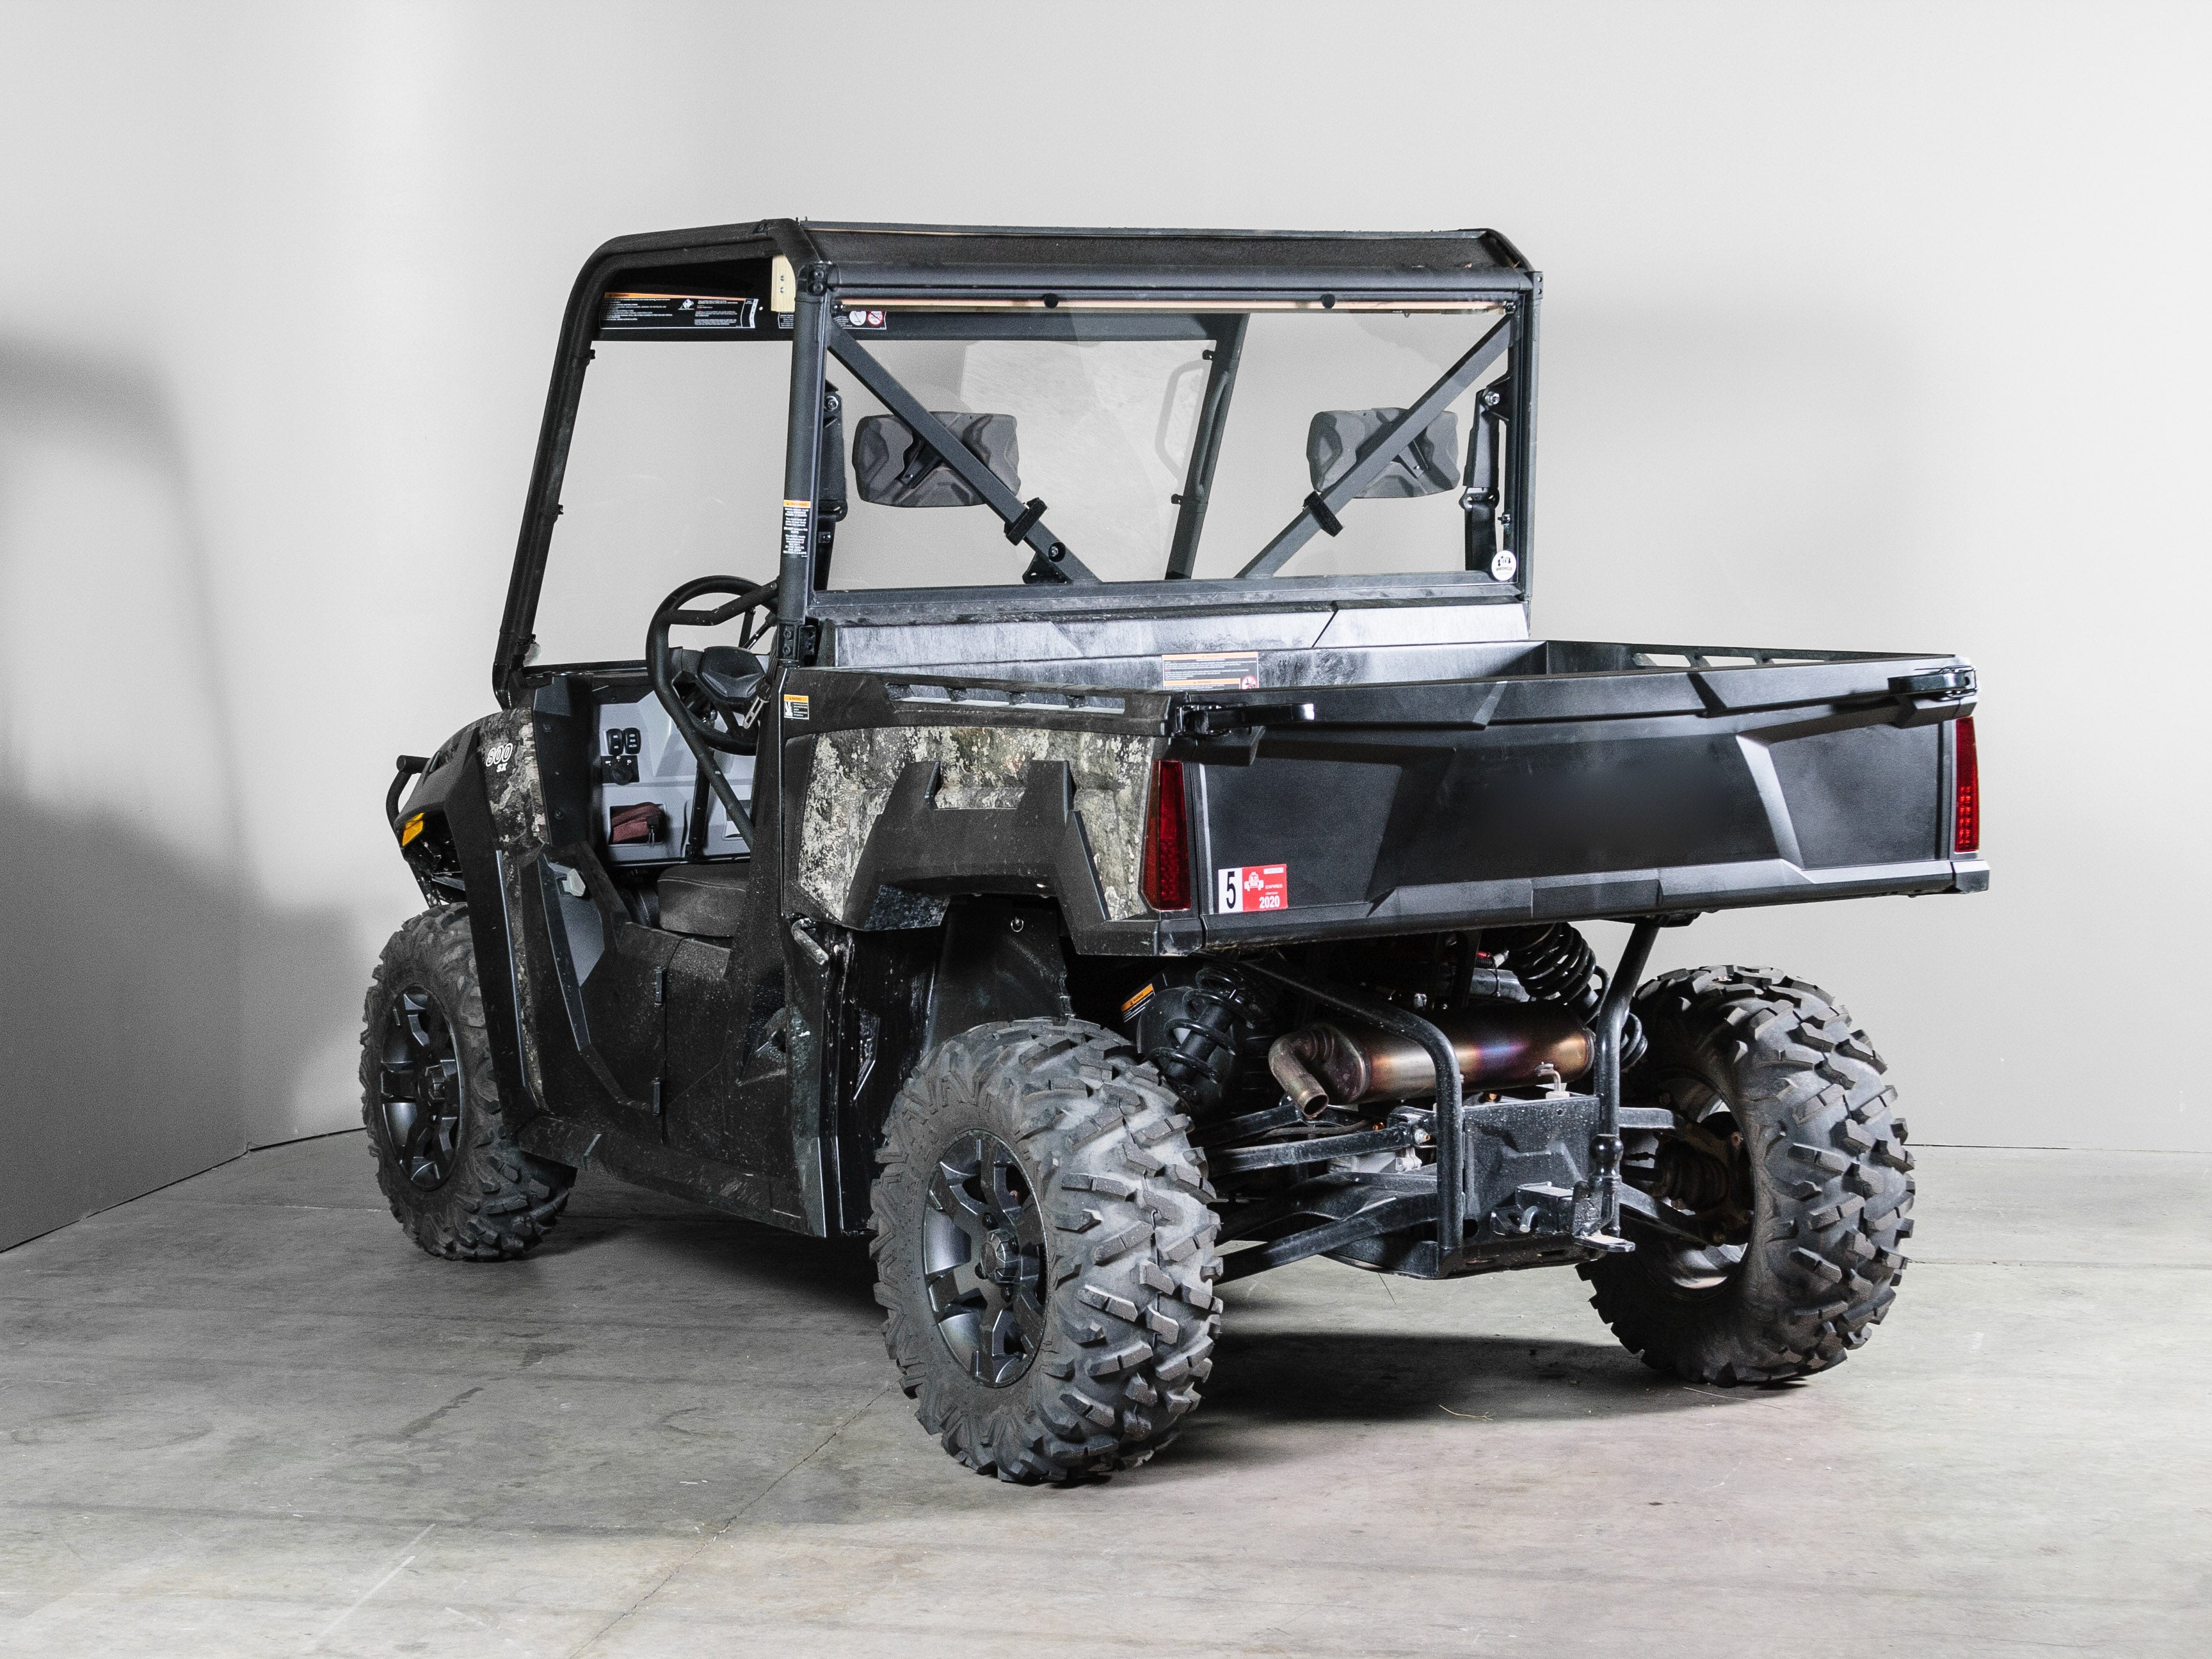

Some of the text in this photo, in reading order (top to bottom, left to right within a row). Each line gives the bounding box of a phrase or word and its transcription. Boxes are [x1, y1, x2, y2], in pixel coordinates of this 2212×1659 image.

[486, 743, 513, 767] 800
[1226, 871, 1236, 909] 5
[1259, 895, 1281, 909] 2020
